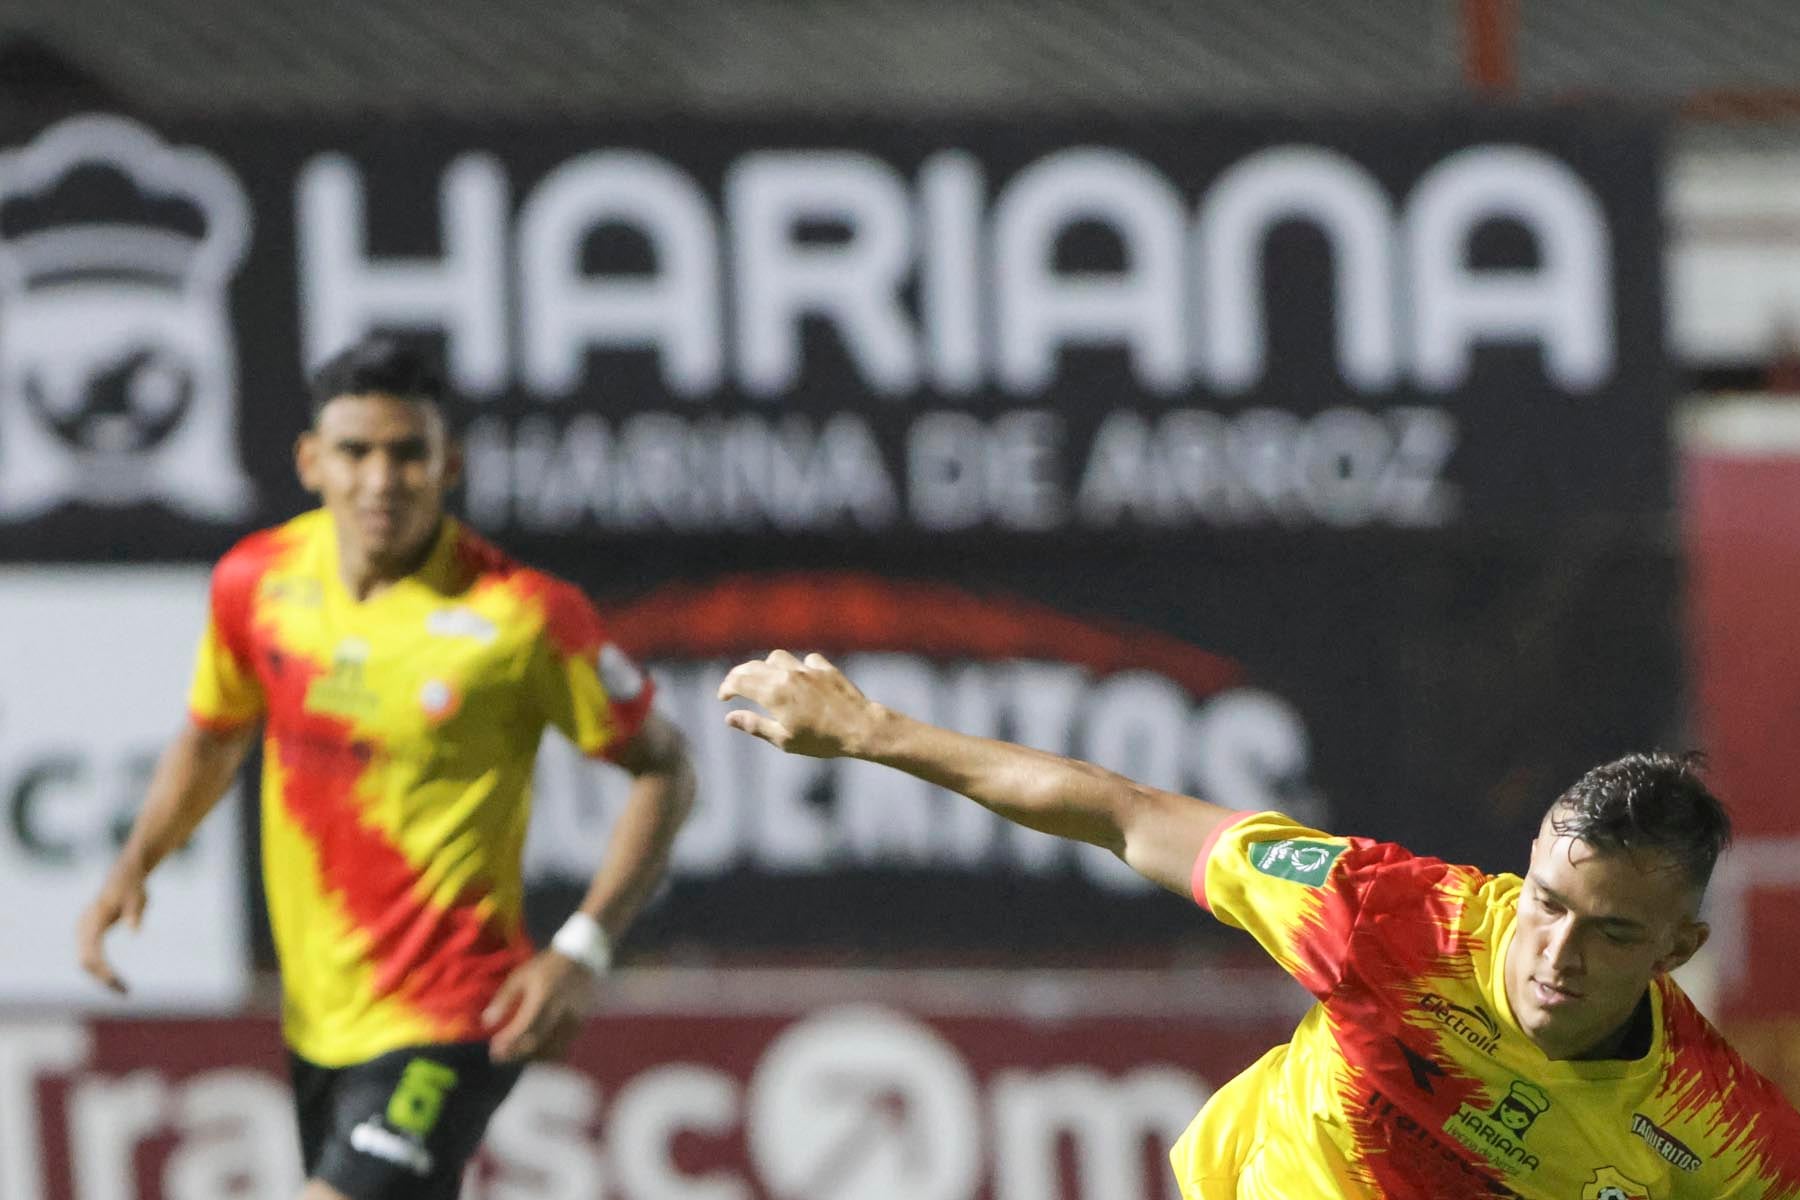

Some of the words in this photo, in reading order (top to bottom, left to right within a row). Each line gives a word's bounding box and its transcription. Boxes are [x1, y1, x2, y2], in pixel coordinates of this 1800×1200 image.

[294, 143, 1614, 398] HARIANA
[462, 412, 897, 532] HARINA
[904, 408, 1064, 532] DE
[1077, 405, 1460, 530] ARROZ
[1420, 992, 1499, 1057] Electrolit
[1456, 1109, 1541, 1173] HARIANA
[1632, 1115, 1701, 1172] TAQUERITOS
